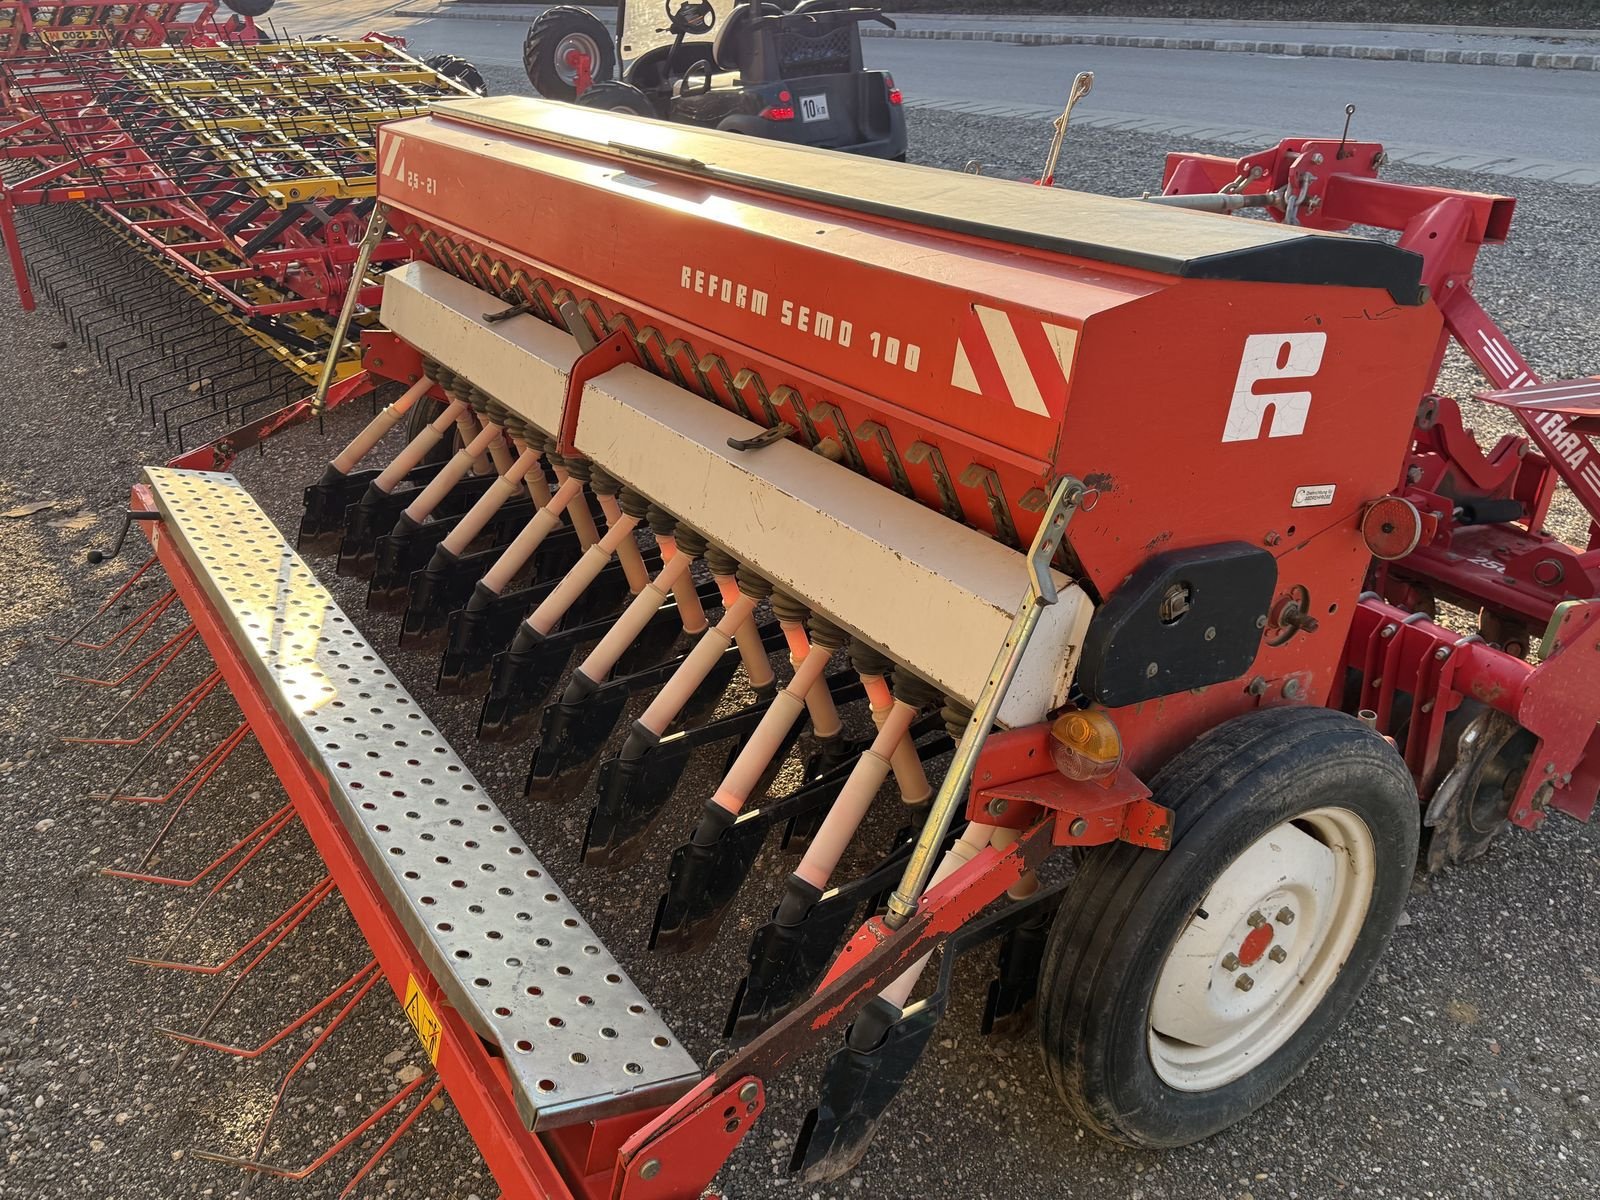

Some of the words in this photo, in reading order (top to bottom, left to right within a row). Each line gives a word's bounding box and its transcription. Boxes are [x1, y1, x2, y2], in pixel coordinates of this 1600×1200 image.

[62, 31, 89, 39] 1200
[803, 99, 816, 119] 10
[680, 265, 769, 317] REFORM
[780, 299, 853, 348] SEMO
[869, 331, 921, 373] 100
